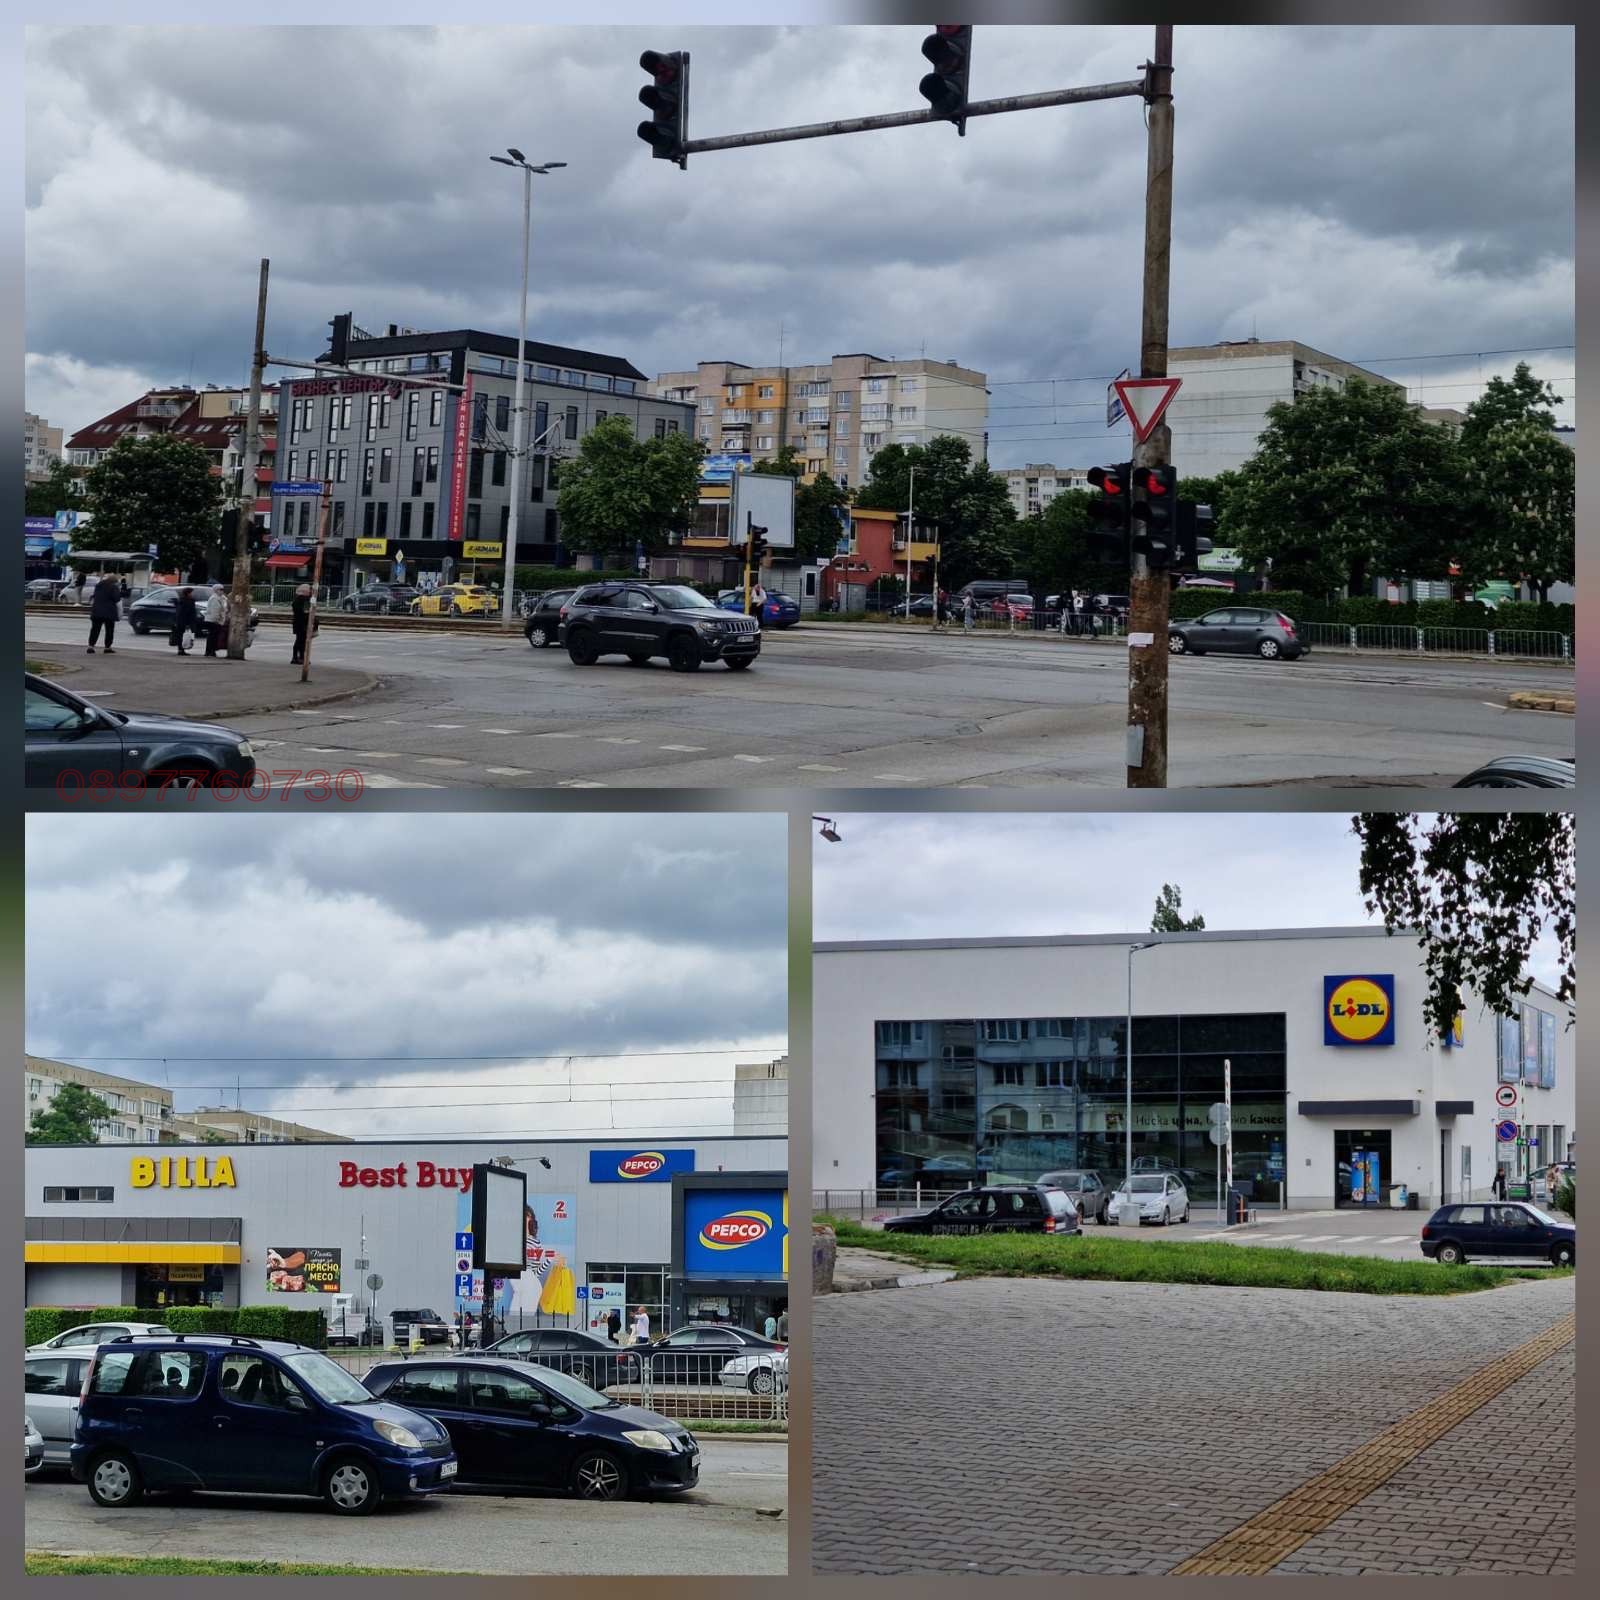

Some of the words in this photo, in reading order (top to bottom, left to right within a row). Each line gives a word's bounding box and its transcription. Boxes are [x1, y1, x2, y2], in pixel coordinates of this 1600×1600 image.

[624, 1158, 660, 1171] PEPCO
[130, 1155, 236, 1188] BILLA
[338, 1161, 408, 1188] Best
[416, 1161, 474, 1193] Buy
[555, 1200, 565, 1212] 2
[709, 1222, 762, 1239] PEPCO
[304, 1263, 339, 1272] ПРЯСНО
[309, 1273, 333, 1281] МЕСО
